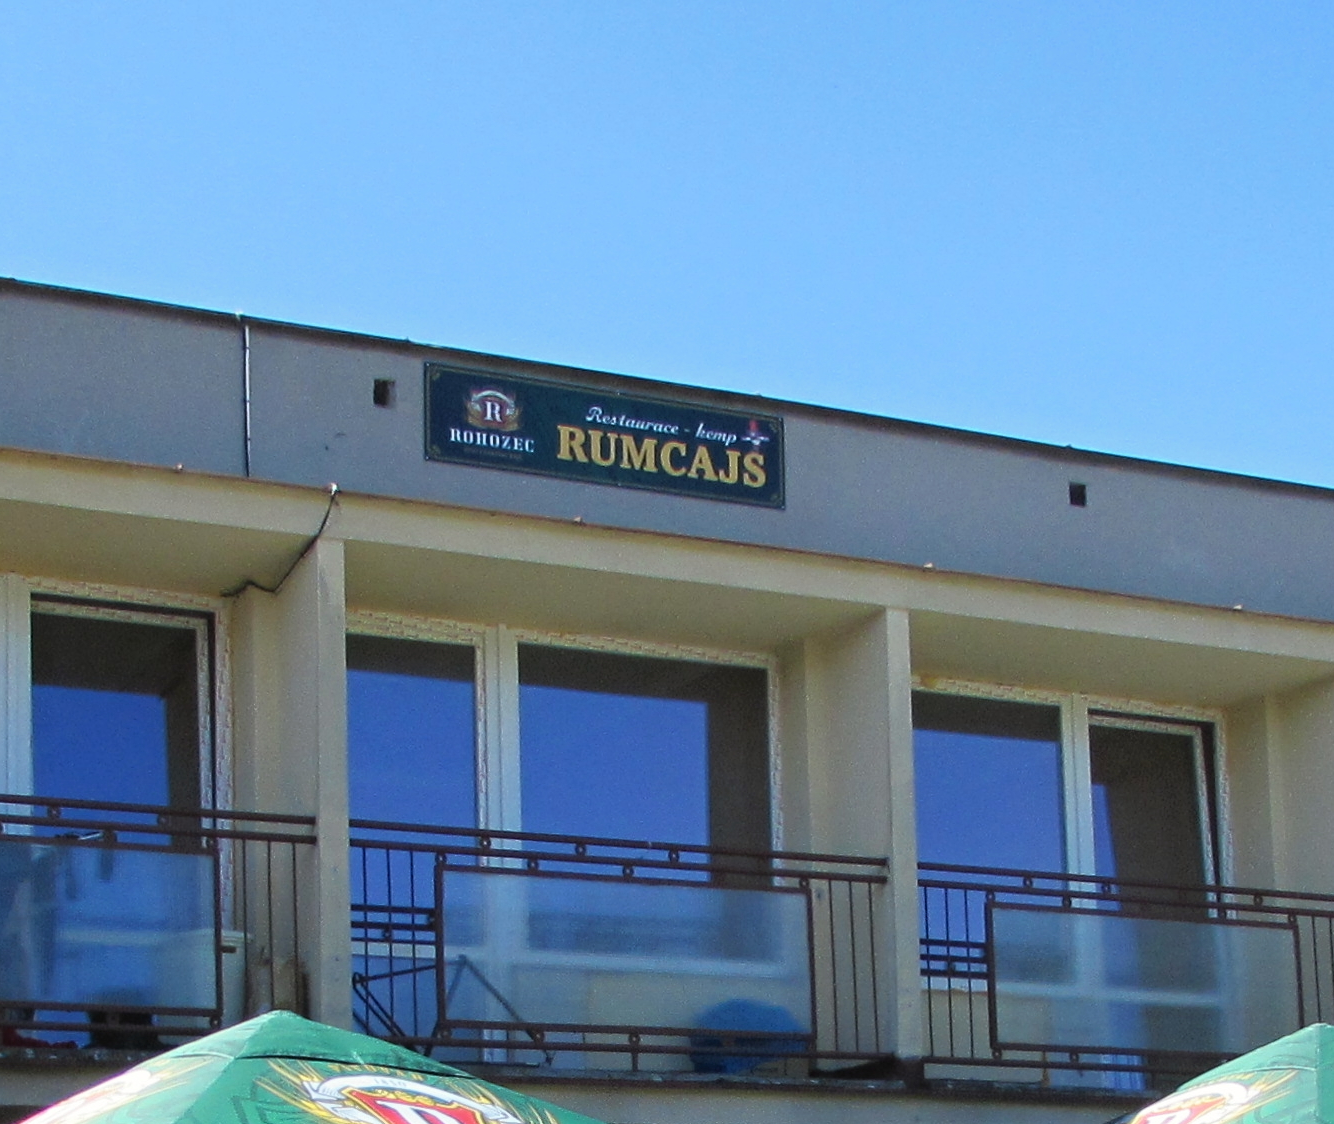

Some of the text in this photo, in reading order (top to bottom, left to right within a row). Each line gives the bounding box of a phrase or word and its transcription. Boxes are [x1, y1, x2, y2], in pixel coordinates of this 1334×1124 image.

[449, 427, 535, 453] ROHOZEC
[585, 406, 679, 435] Restaurace
[696, 422, 738, 445] kemp
[556, 424, 766, 488] RUMCAJS
